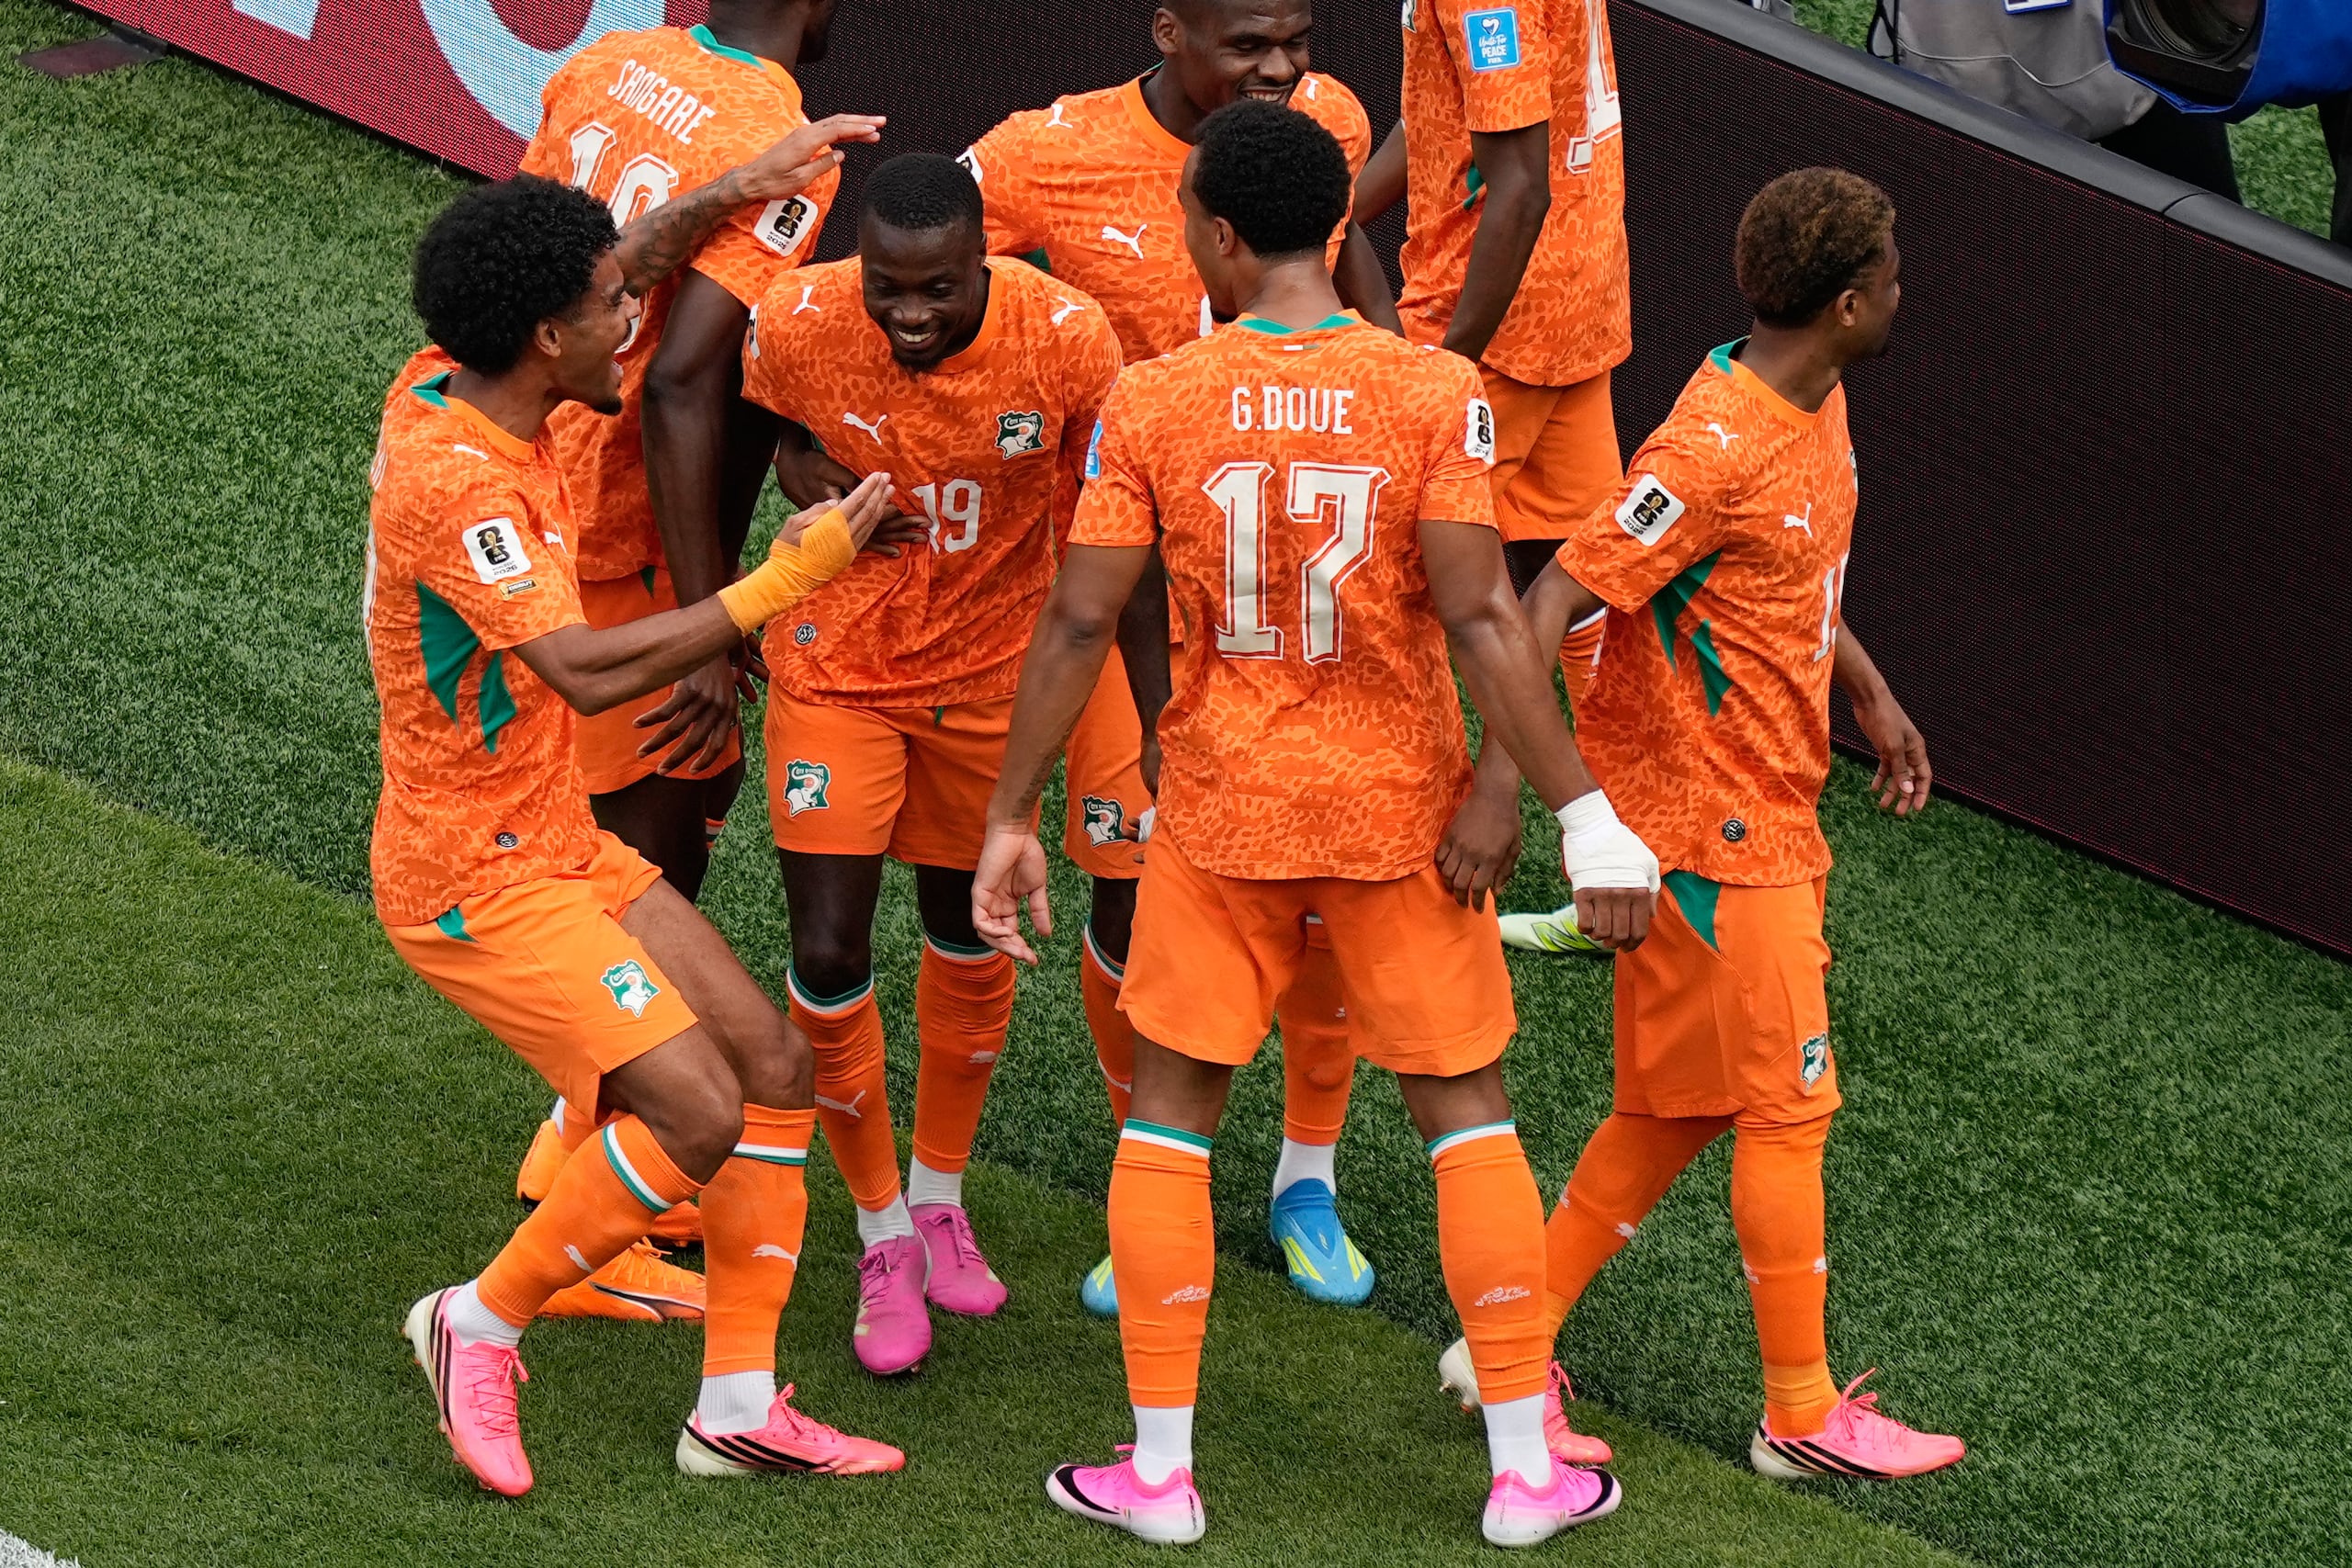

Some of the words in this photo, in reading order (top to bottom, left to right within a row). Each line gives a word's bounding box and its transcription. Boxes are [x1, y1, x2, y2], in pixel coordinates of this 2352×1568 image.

[1481, 45, 1508, 59] PEACE
[606, 59, 716, 145] SANGARE
[1231, 385, 1355, 434] G.DOUE
[910, 478, 983, 556] 19
[1200, 460, 1393, 666] 17
